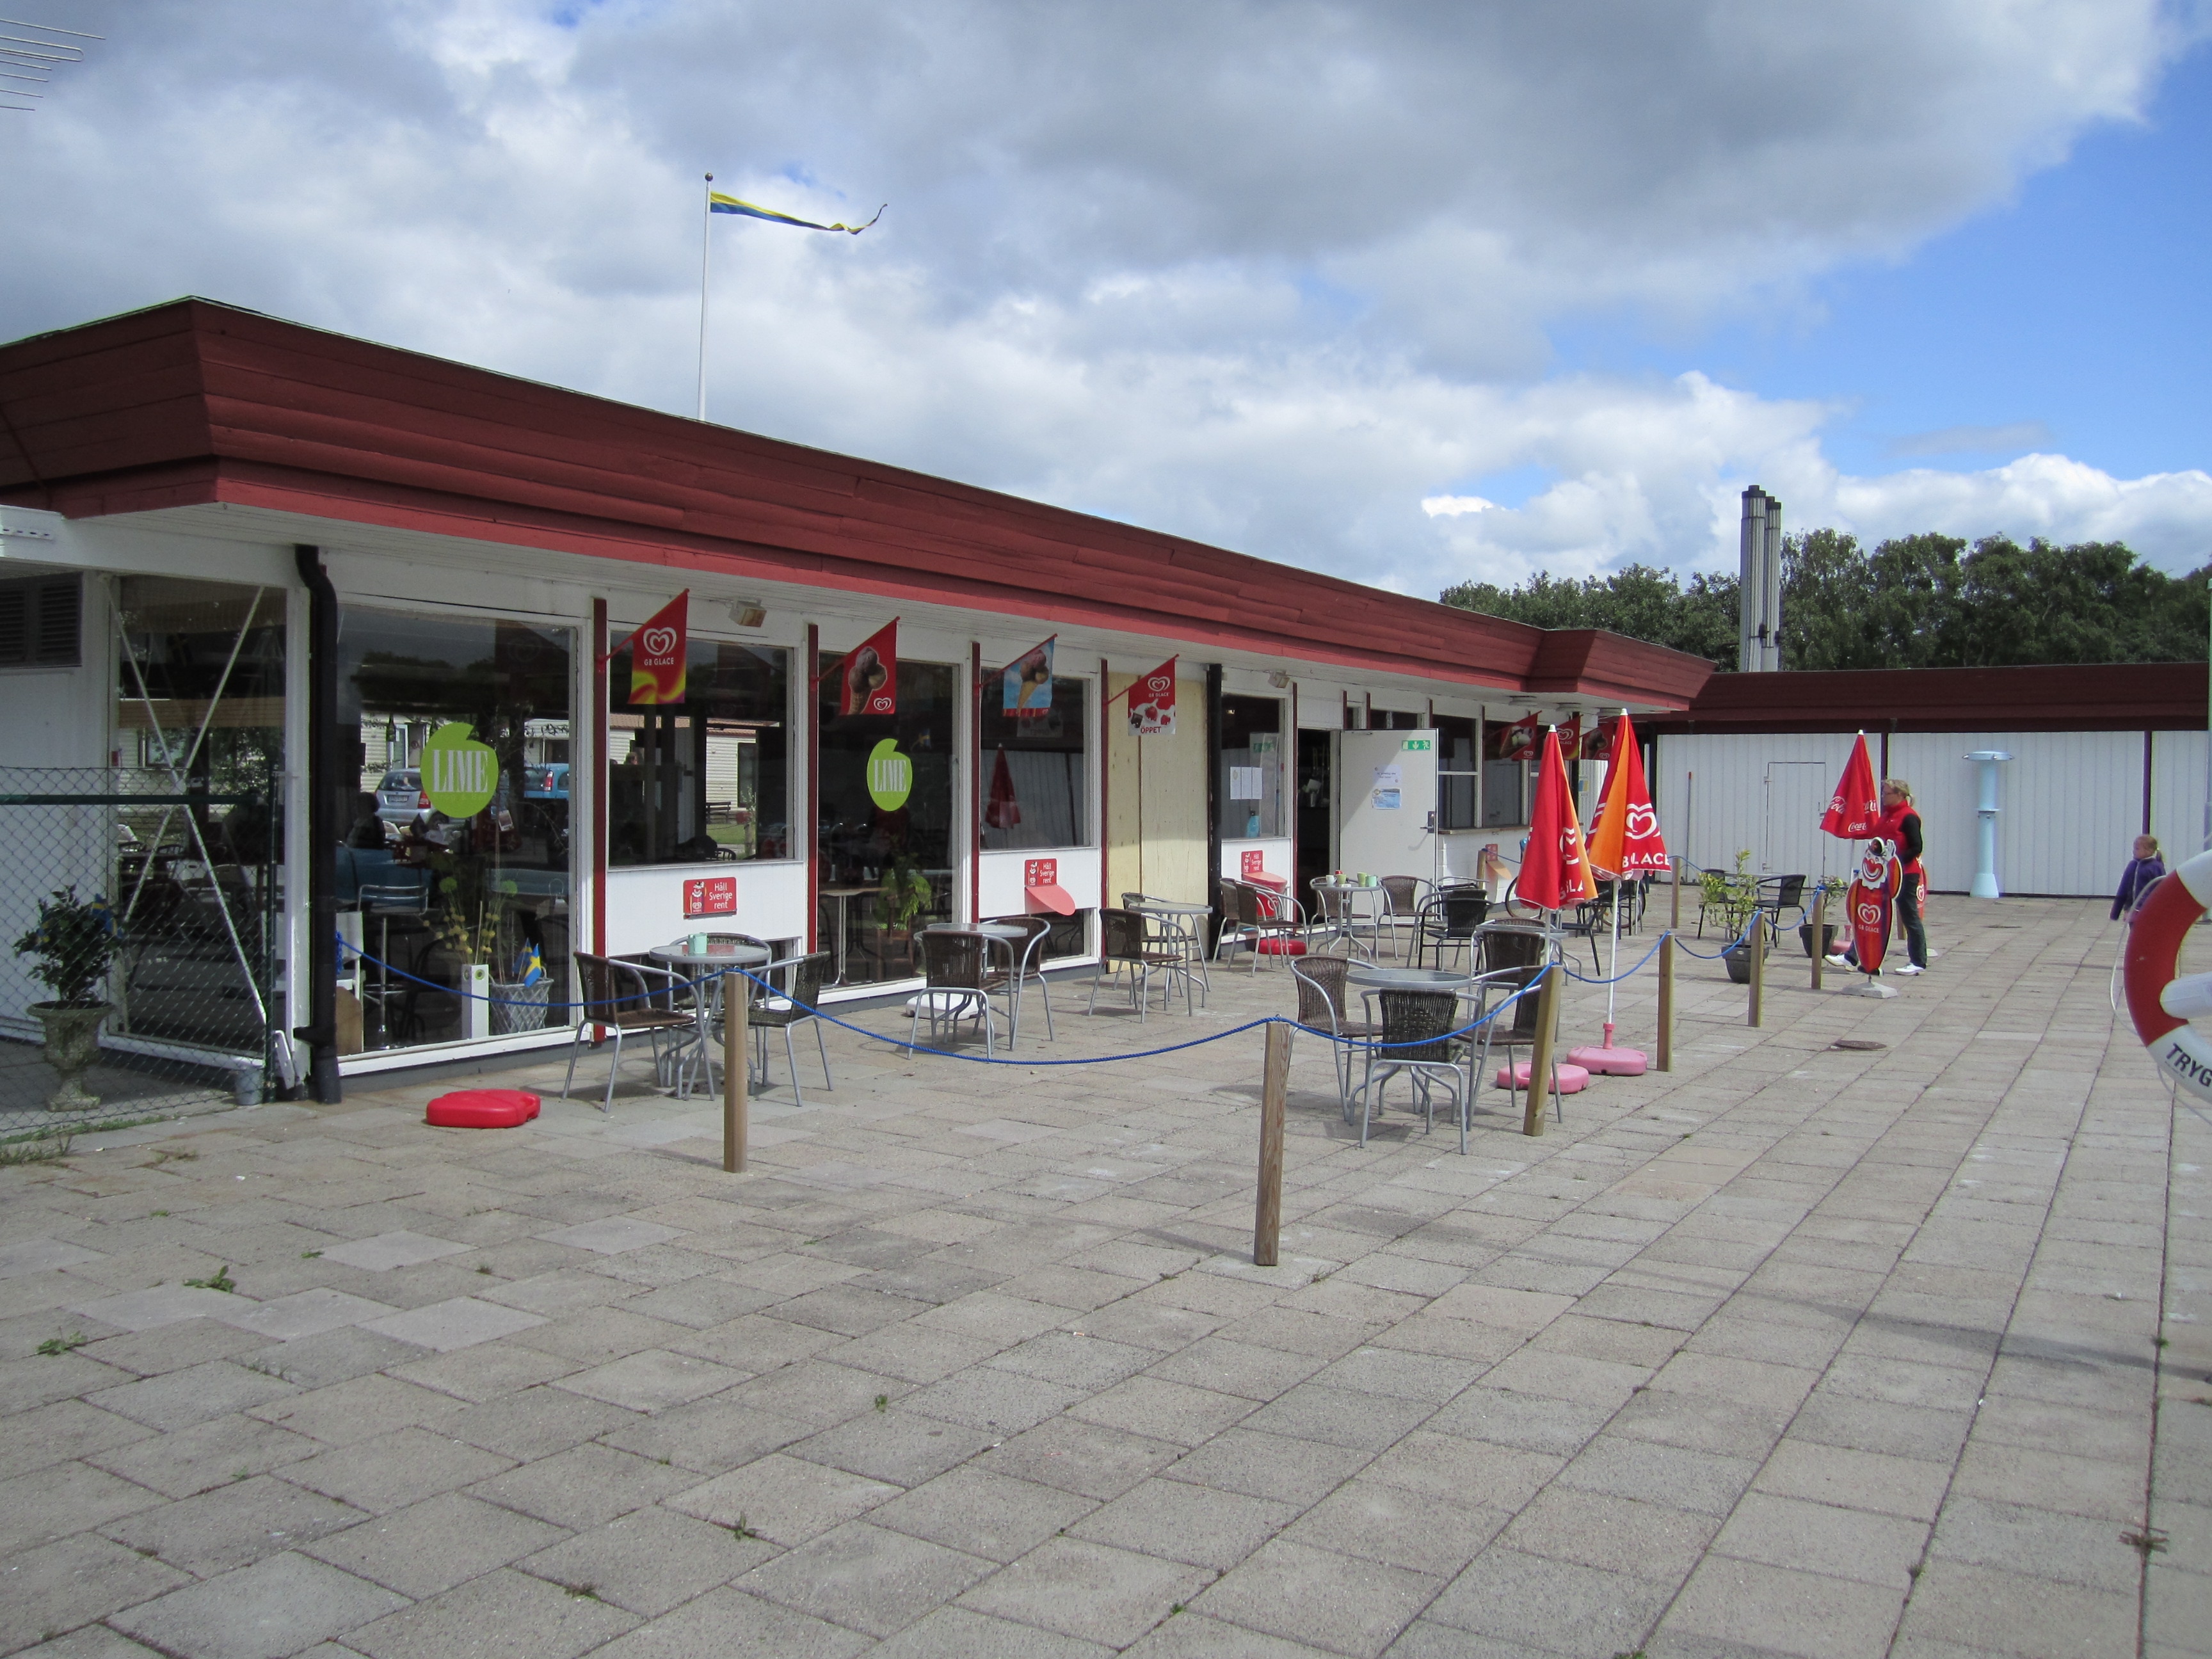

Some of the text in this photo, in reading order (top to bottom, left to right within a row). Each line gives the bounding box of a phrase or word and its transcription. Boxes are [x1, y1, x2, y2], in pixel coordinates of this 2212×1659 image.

[653, 657, 674, 666] GLACE
[1141, 725, 1161, 733] ÖPPET
[433, 749, 488, 793] LIME
[874, 759, 906, 792] LIME
[1039, 870, 1055, 878] Sverige
[714, 881, 728, 891] Håll
[709, 891, 733, 901] Sverige
[714, 901, 728, 910] rent
[1866, 925, 1879, 933] GLACE
[2166, 1042, 2212, 1087] TRYG
